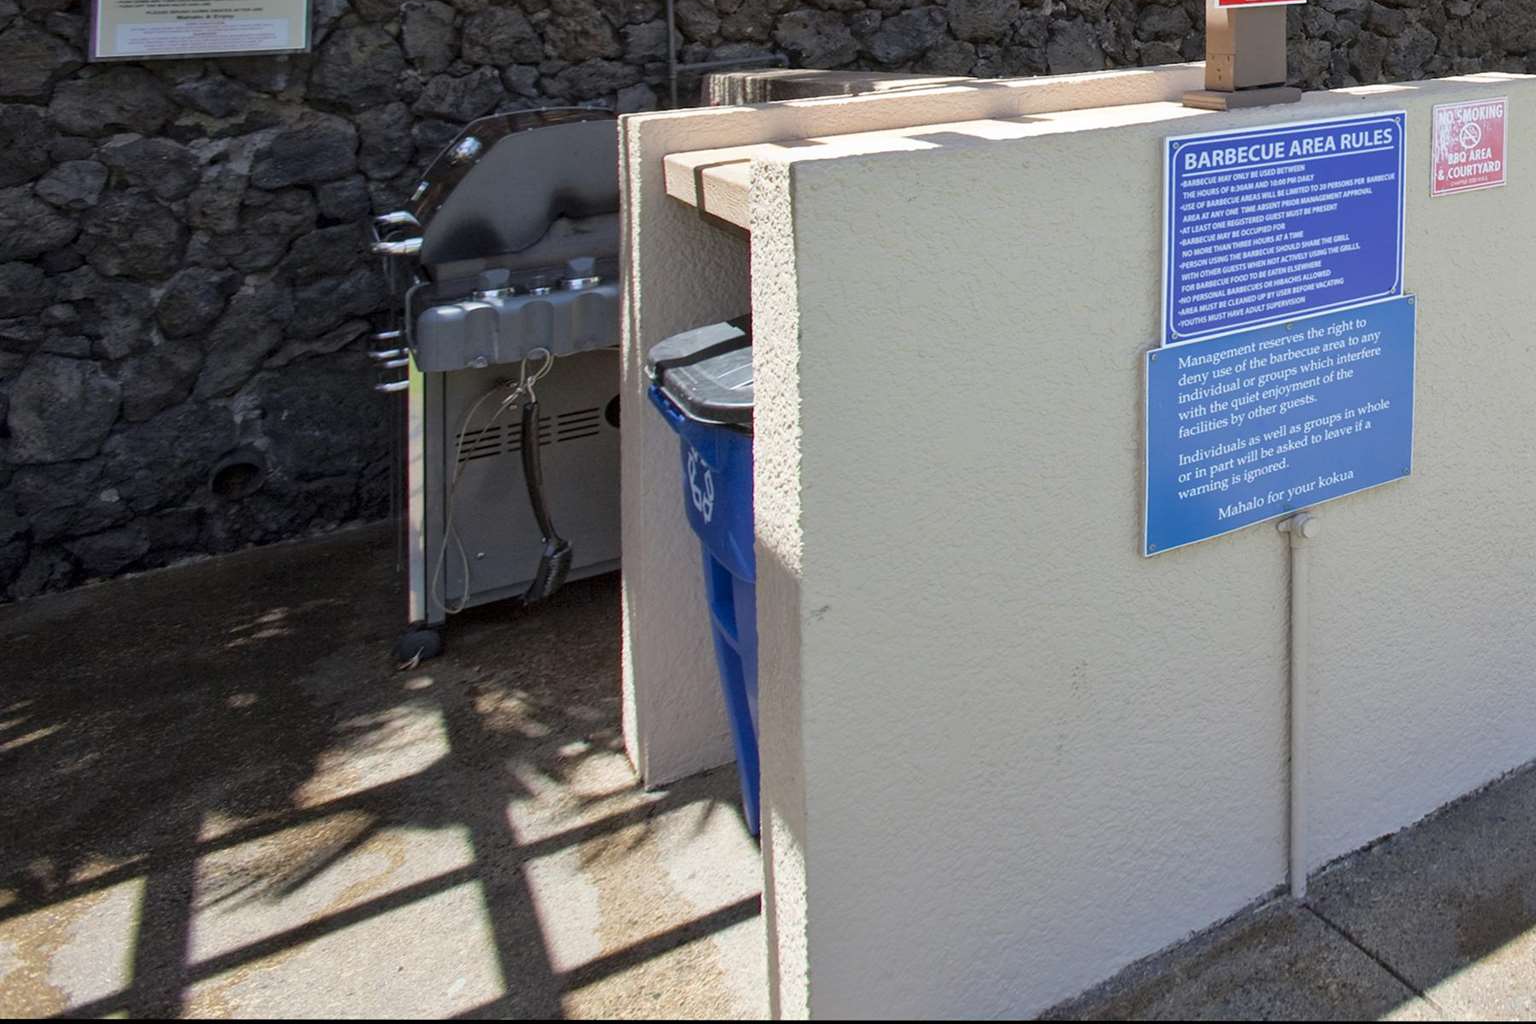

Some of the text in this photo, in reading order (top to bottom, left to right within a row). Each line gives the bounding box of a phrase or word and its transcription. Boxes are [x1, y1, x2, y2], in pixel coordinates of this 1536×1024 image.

[1439, 104, 1503, 124] NO SMOKING
[1184, 128, 1393, 170] BARBECUE AREA RULES
[1447, 147, 1492, 165] BBQ AREA
[1182, 164, 1305, 187] BARBECUE MAY ONLY BE USED BETWEEN
[1448, 160, 1501, 179] COURTYARD
[1183, 190, 1195, 199] THE
[1196, 187, 1219, 197] HOURS
[1220, 186, 1229, 194] OF
[1254, 180, 1269, 189] AND
[1181, 222, 1285, 246] BARBECUE MAY BE OCCUPIED FOR
[1182, 203, 1337, 234] AT LEAST ONE REGISTERED GUEST MUST BE PRESENT
[1182, 249, 1193, 257] NO
[1193, 246, 1212, 256] MORE
[1213, 243, 1231, 252] THAN
[1232, 239, 1251, 249] THREE
[1252, 235, 1274, 245] HOURS
[1289, 230, 1303, 239] TIME
[1180, 295, 1191, 304] NO
[1192, 290, 1225, 302] PERSONAL
[1227, 282, 1263, 295] BARBECUES
[1263, 280, 1272, 288] OR
[1302, 269, 1331, 280] ALLOWED
[1180, 296, 1305, 327] YOUTHS MUST HAVE ADULT SUPERVISION
[1178, 319, 1367, 369] Management reserves the right to
[1178, 331, 1380, 386] deny use of the barbecue area to any
[1178, 347, 1381, 404] individual or groups which interfere
[1178, 369, 1353, 420] with the quiet enjoyment of the
[1179, 394, 1317, 438] facilities by other guests.
[1179, 399, 1390, 465] Individuals as well as groups in whole
[1178, 419, 1371, 483] or in part will be asked to leave if a
[1178, 458, 1289, 499] warning is ignored.
[1218, 470, 1353, 520] Mahalo for your kokua
